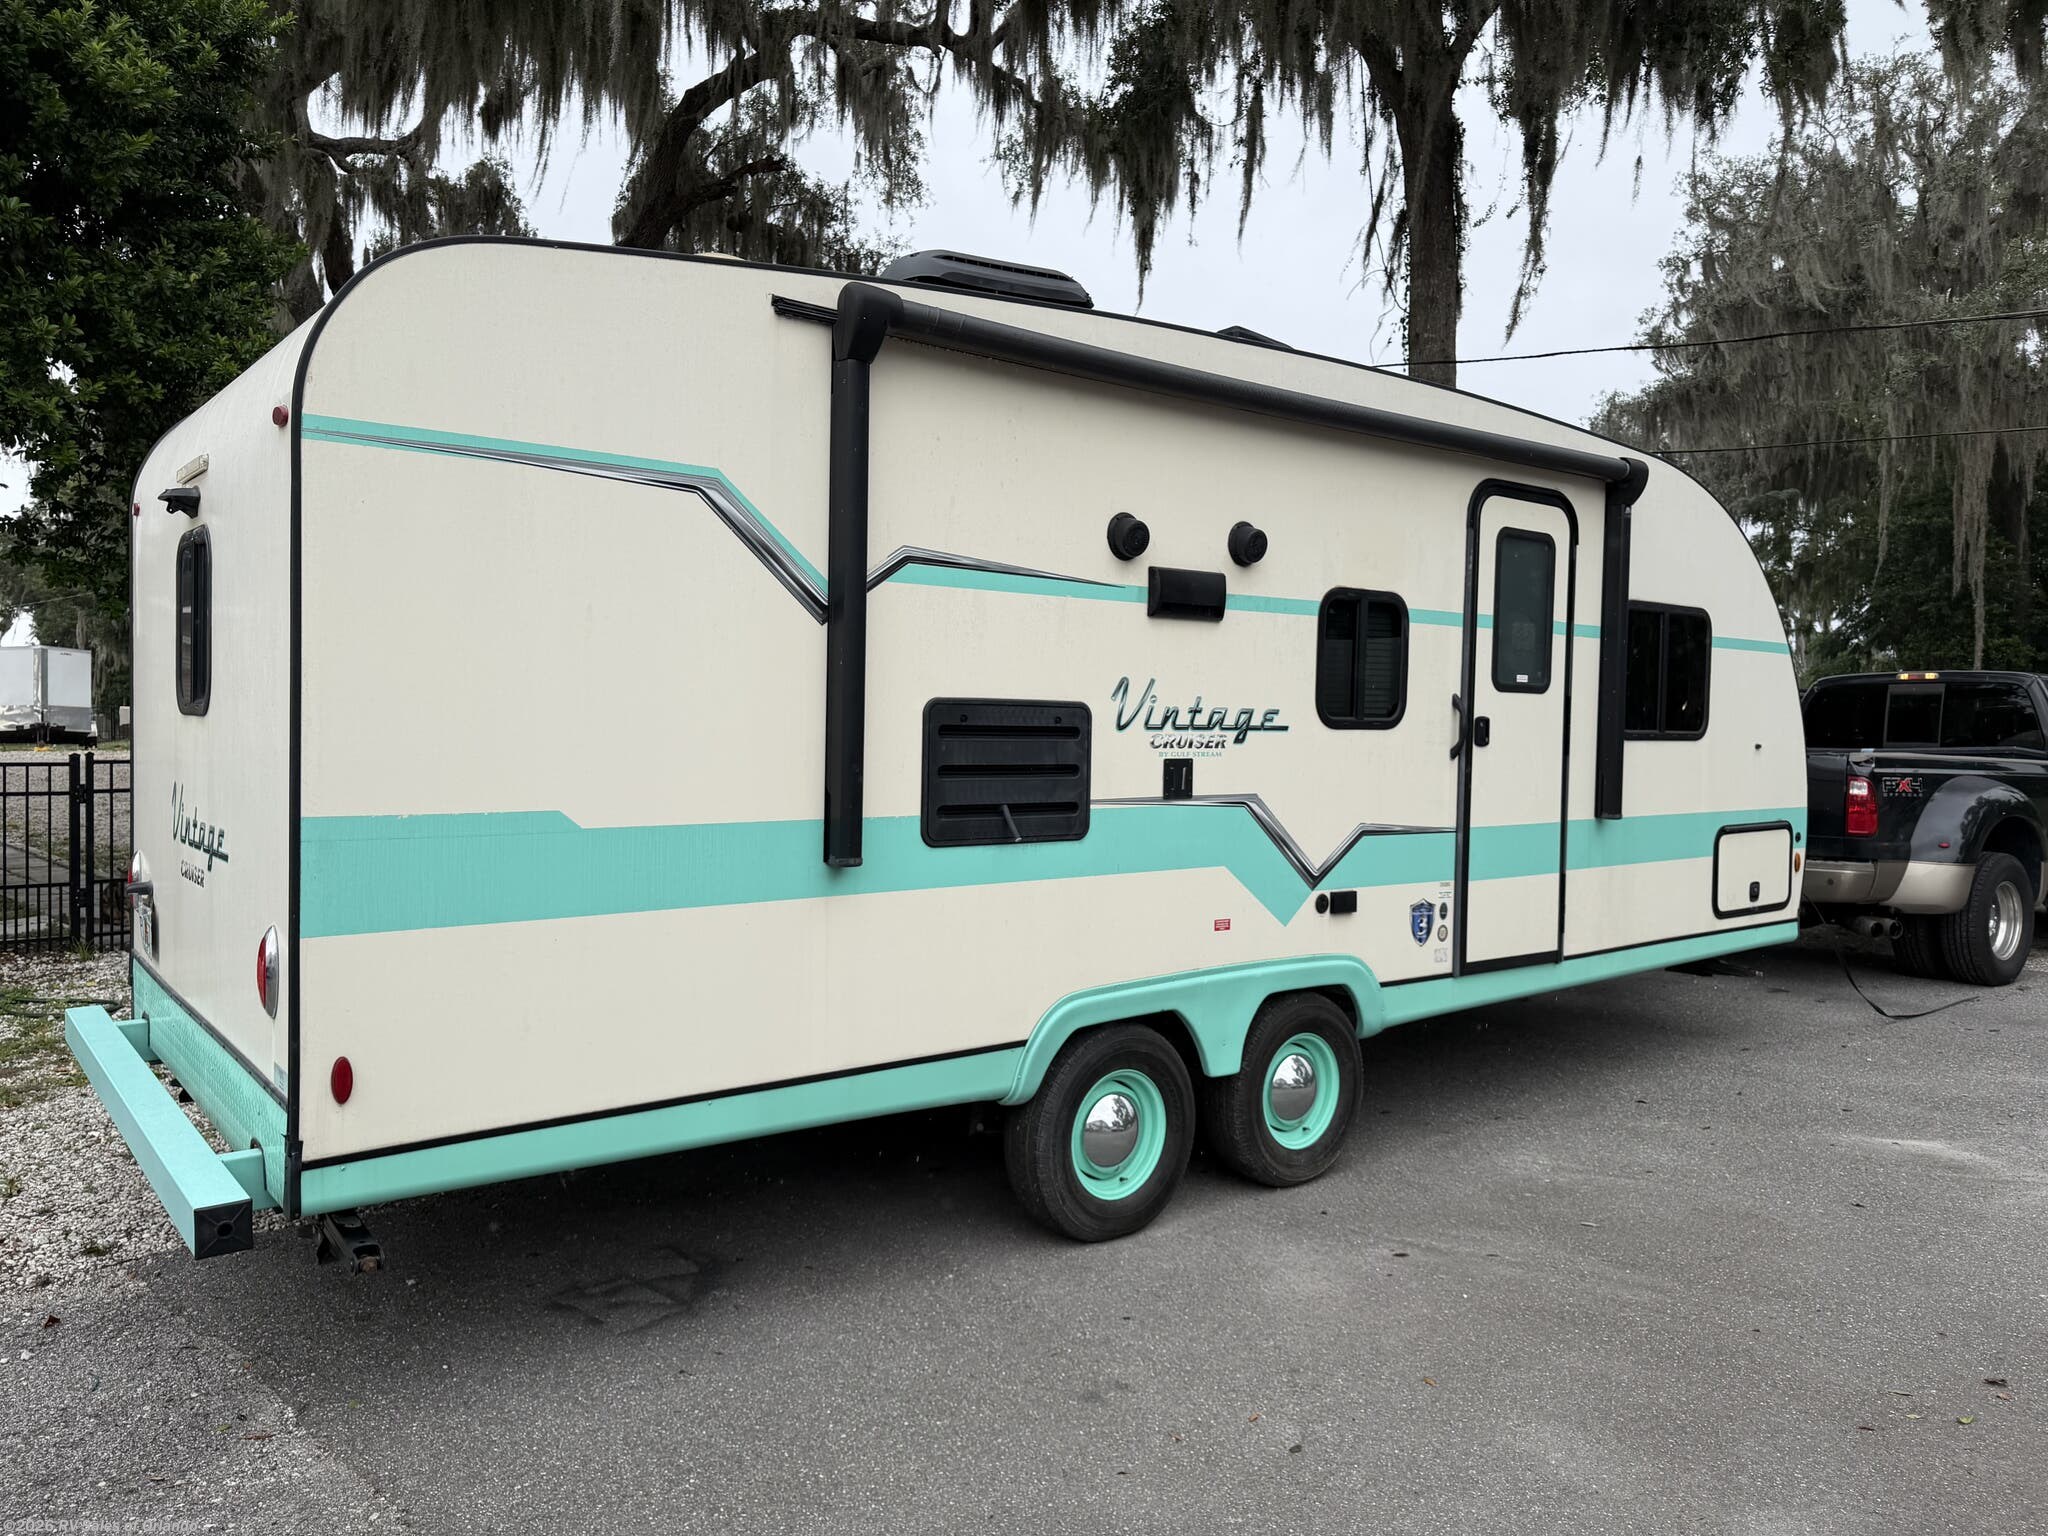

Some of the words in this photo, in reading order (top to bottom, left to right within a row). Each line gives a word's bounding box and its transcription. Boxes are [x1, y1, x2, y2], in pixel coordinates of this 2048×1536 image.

[1111, 677, 1289, 744] Vintage
[1150, 733, 1227, 749] CRUISER
[1882, 777, 1923, 792] FX4
[172, 781, 229, 872] Vintage
[180, 859, 205, 888] CRUISER
